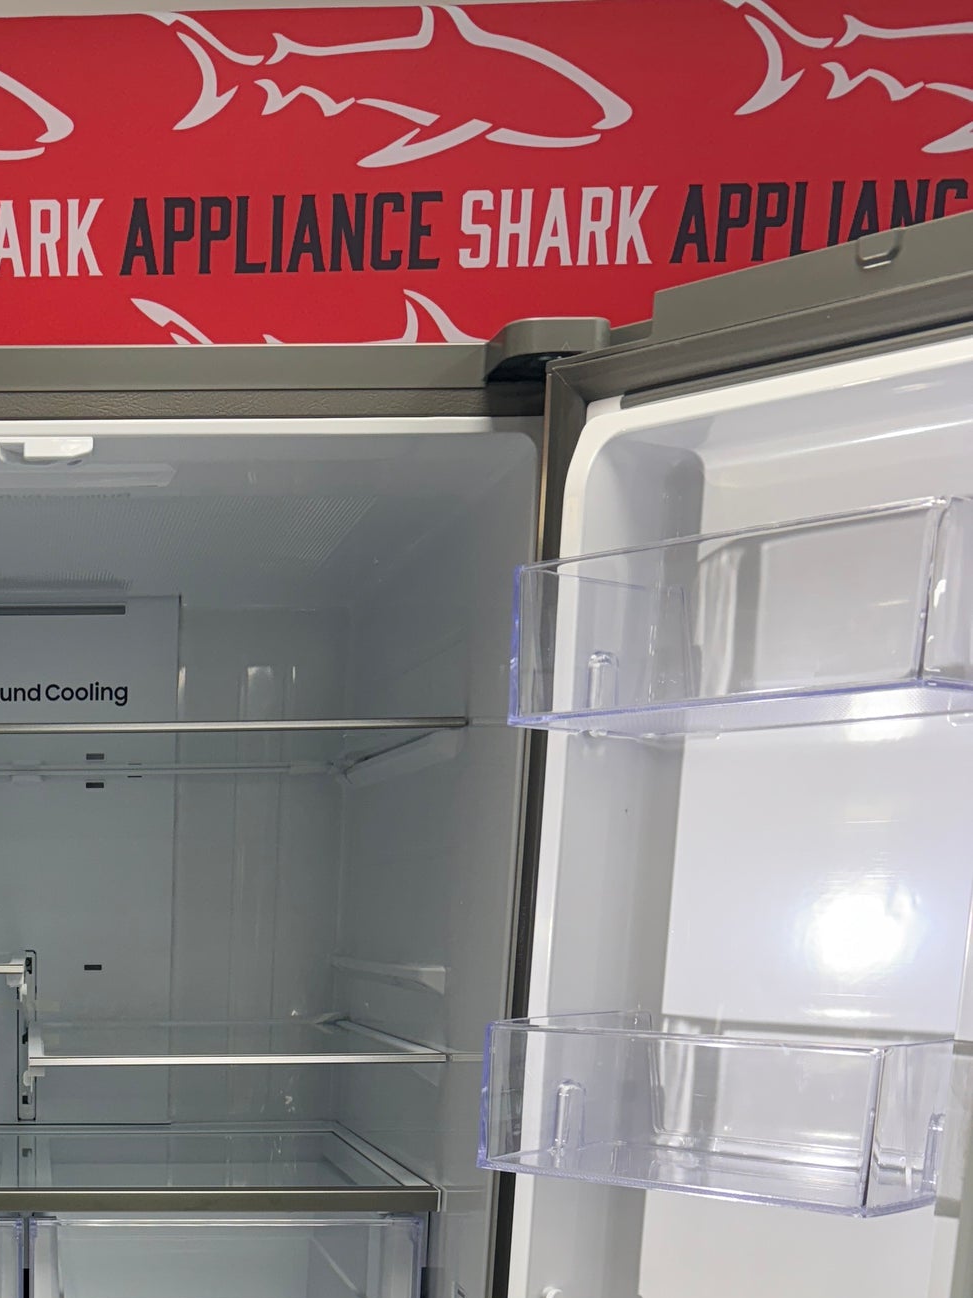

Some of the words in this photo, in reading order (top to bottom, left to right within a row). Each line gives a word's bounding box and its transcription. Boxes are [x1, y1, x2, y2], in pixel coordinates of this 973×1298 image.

[119, 190, 443, 276] APPLIANCE
[459, 185, 659, 269] SHARK
[45, 681, 128, 706] Cooling
